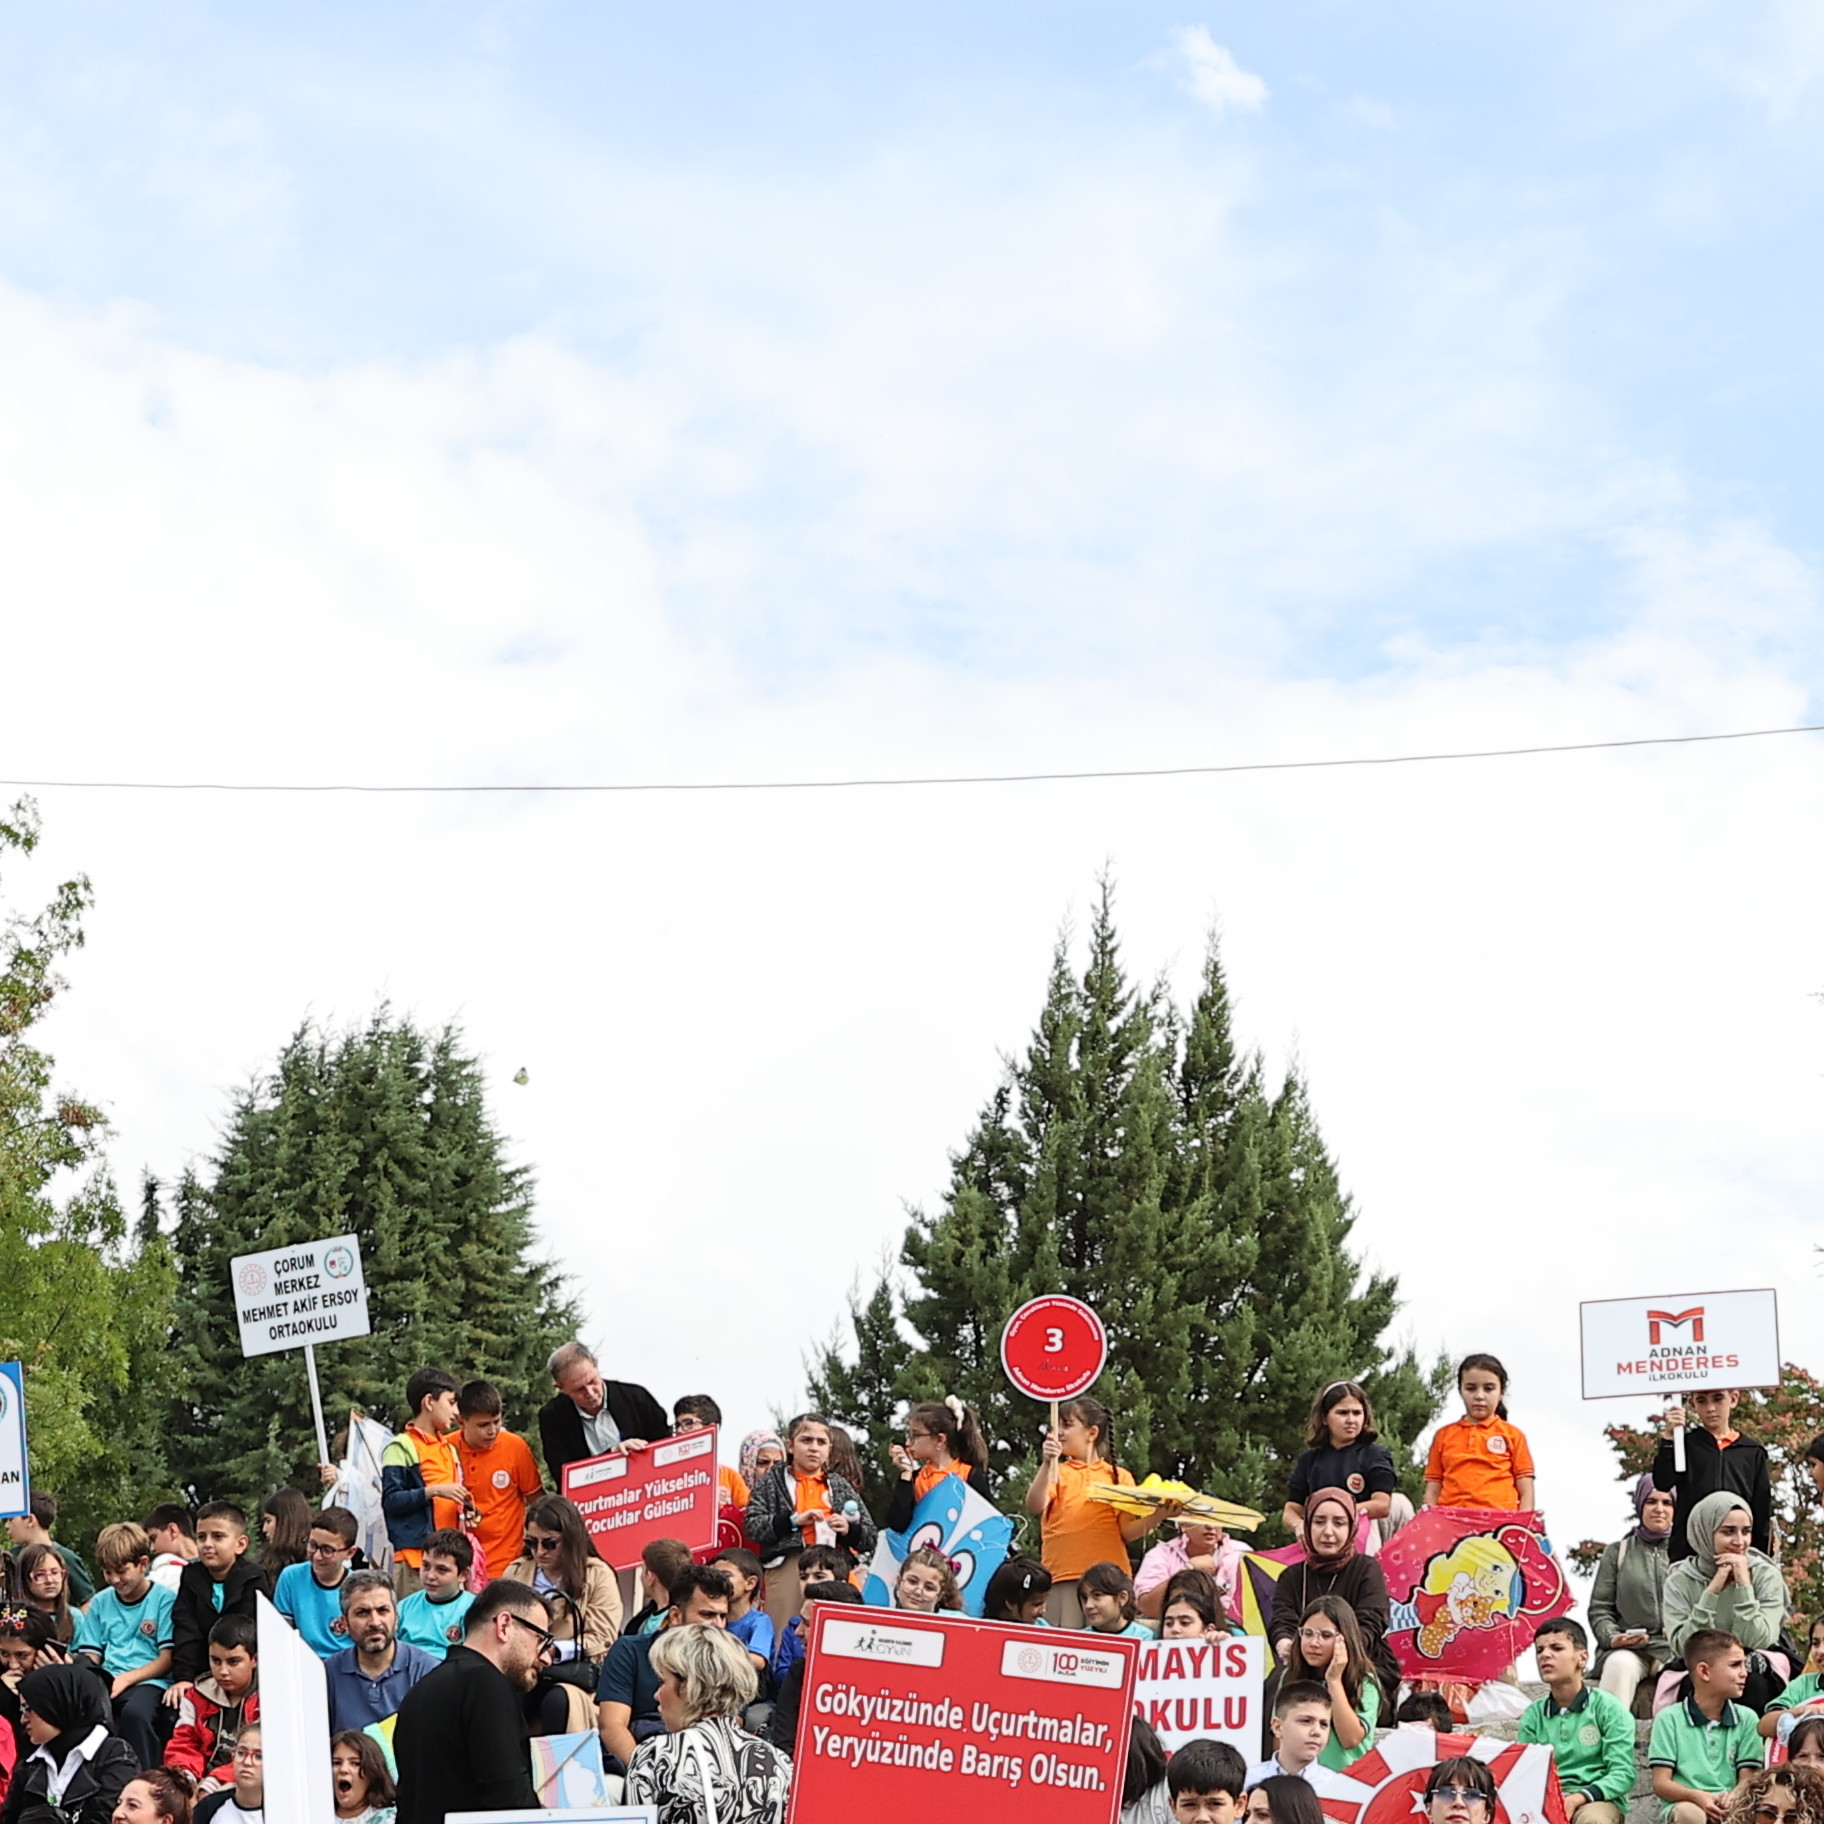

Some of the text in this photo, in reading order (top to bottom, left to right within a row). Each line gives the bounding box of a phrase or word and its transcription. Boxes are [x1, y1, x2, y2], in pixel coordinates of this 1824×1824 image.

[274, 1253, 315, 1278] ÇORUM
[274, 1274, 321, 1296] MERKEZ
[242, 1288, 359, 1324] MEHMET AKİF ERSOY
[269, 1313, 338, 1340] ORTAOKULU
[1044, 1327, 1065, 1353] 3
[1616, 1354, 1740, 1375] MENDERES
[1649, 1345, 1707, 1358] ADNAN
[644, 1469, 712, 1499] Yükselsin,
[643, 1492, 695, 1521] Gülsün!
[815, 1683, 1114, 1753] Gökyüzünde Uçurtmalar,
[812, 1725, 1106, 1791] Yeryüzünde Barış Olsun.
